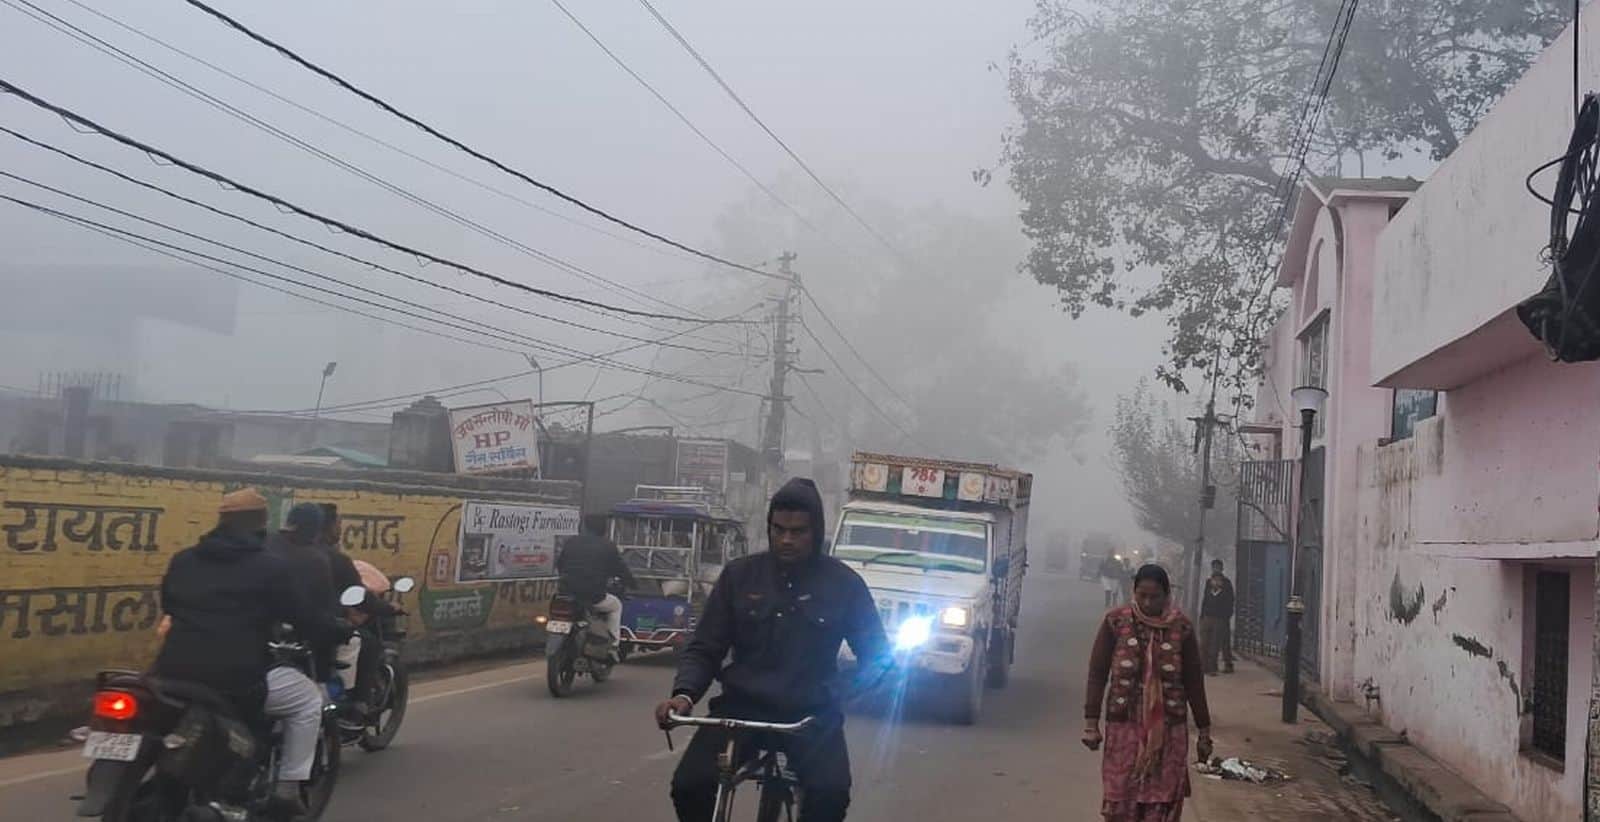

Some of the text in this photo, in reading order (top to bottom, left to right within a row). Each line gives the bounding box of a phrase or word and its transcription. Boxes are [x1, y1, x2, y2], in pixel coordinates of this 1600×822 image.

[473, 430, 511, 449] HP
[910, 467, 939, 484] 786
[1, 501, 166, 552] रायता
[489, 508, 531, 534] Rastogi
